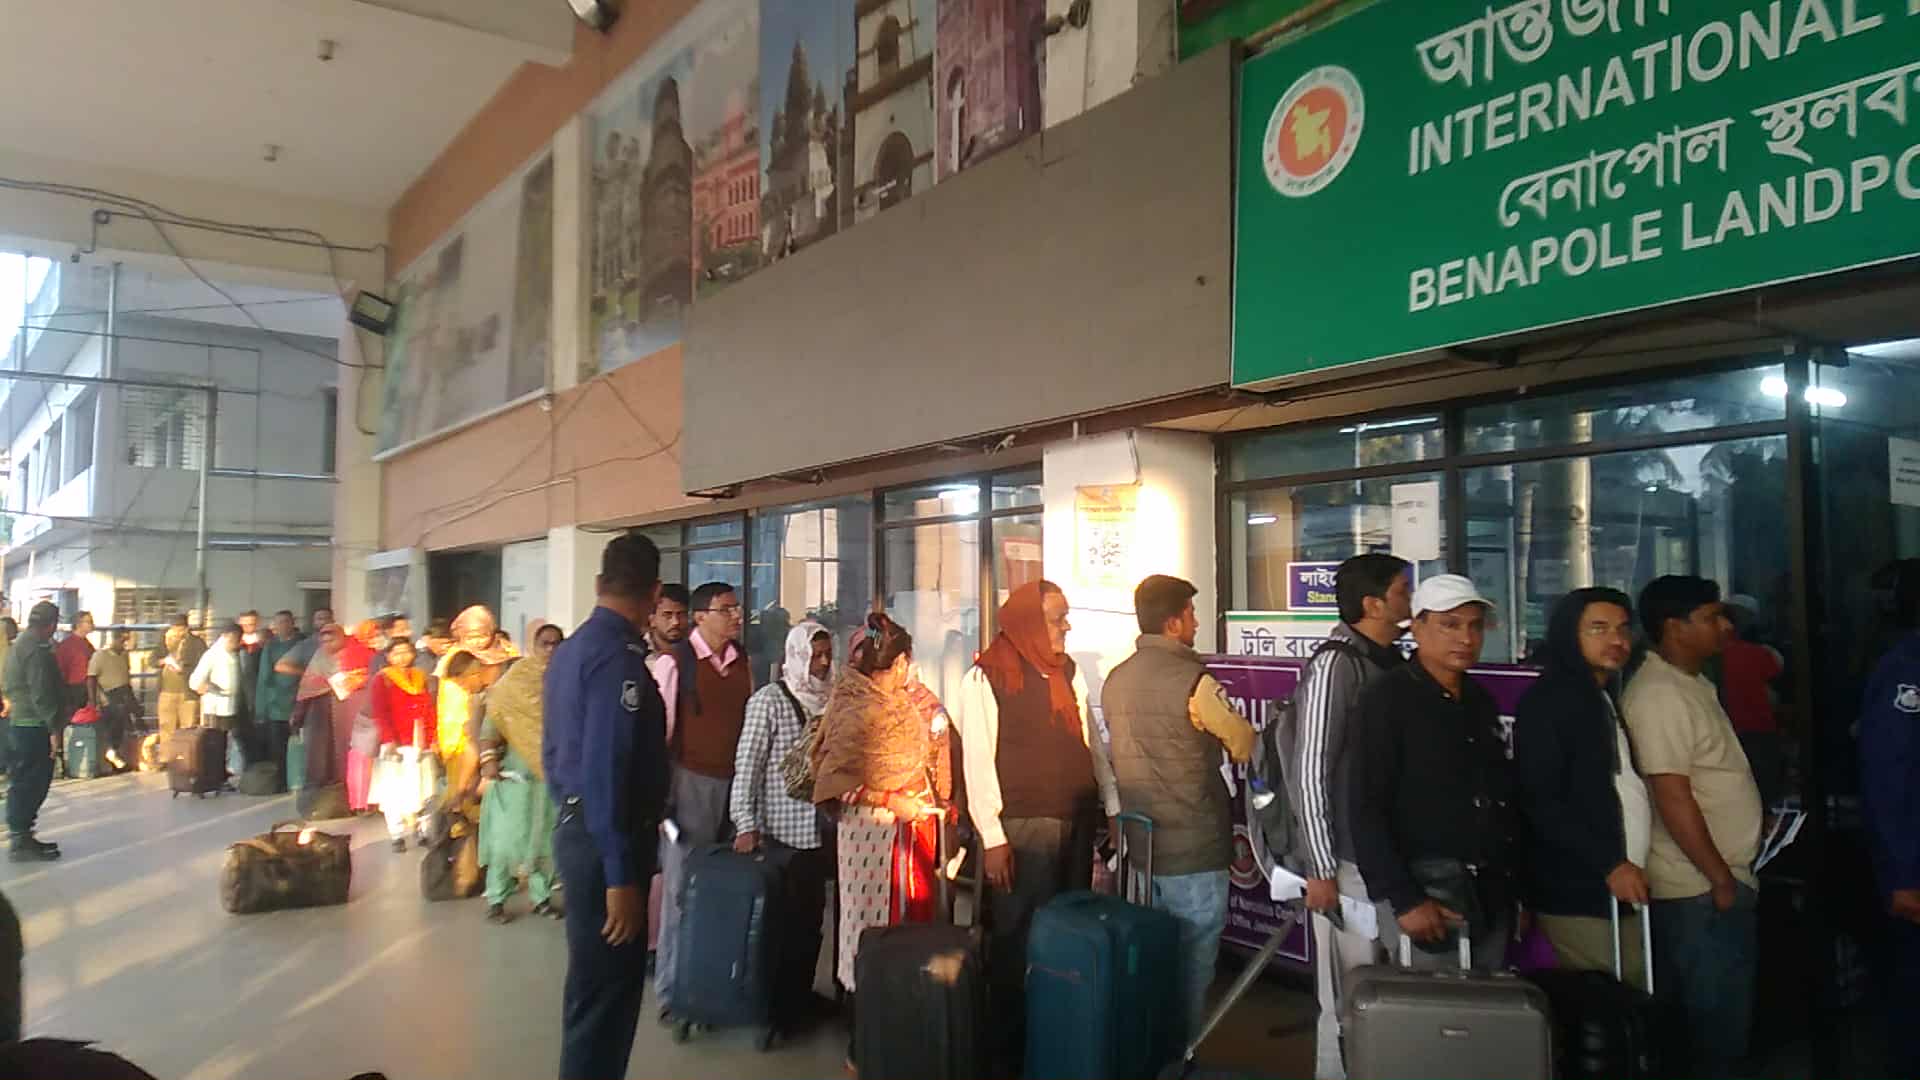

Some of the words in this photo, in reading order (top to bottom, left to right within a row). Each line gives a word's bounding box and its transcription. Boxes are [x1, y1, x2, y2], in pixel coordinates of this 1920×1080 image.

[1408, 0, 1884, 176] INTERNATIONAL
[1499, 117, 1735, 228] বেনাপোল
[1751, 61, 1920, 165] স্থলব
[1408, 208, 1664, 313] BENAPOLE
